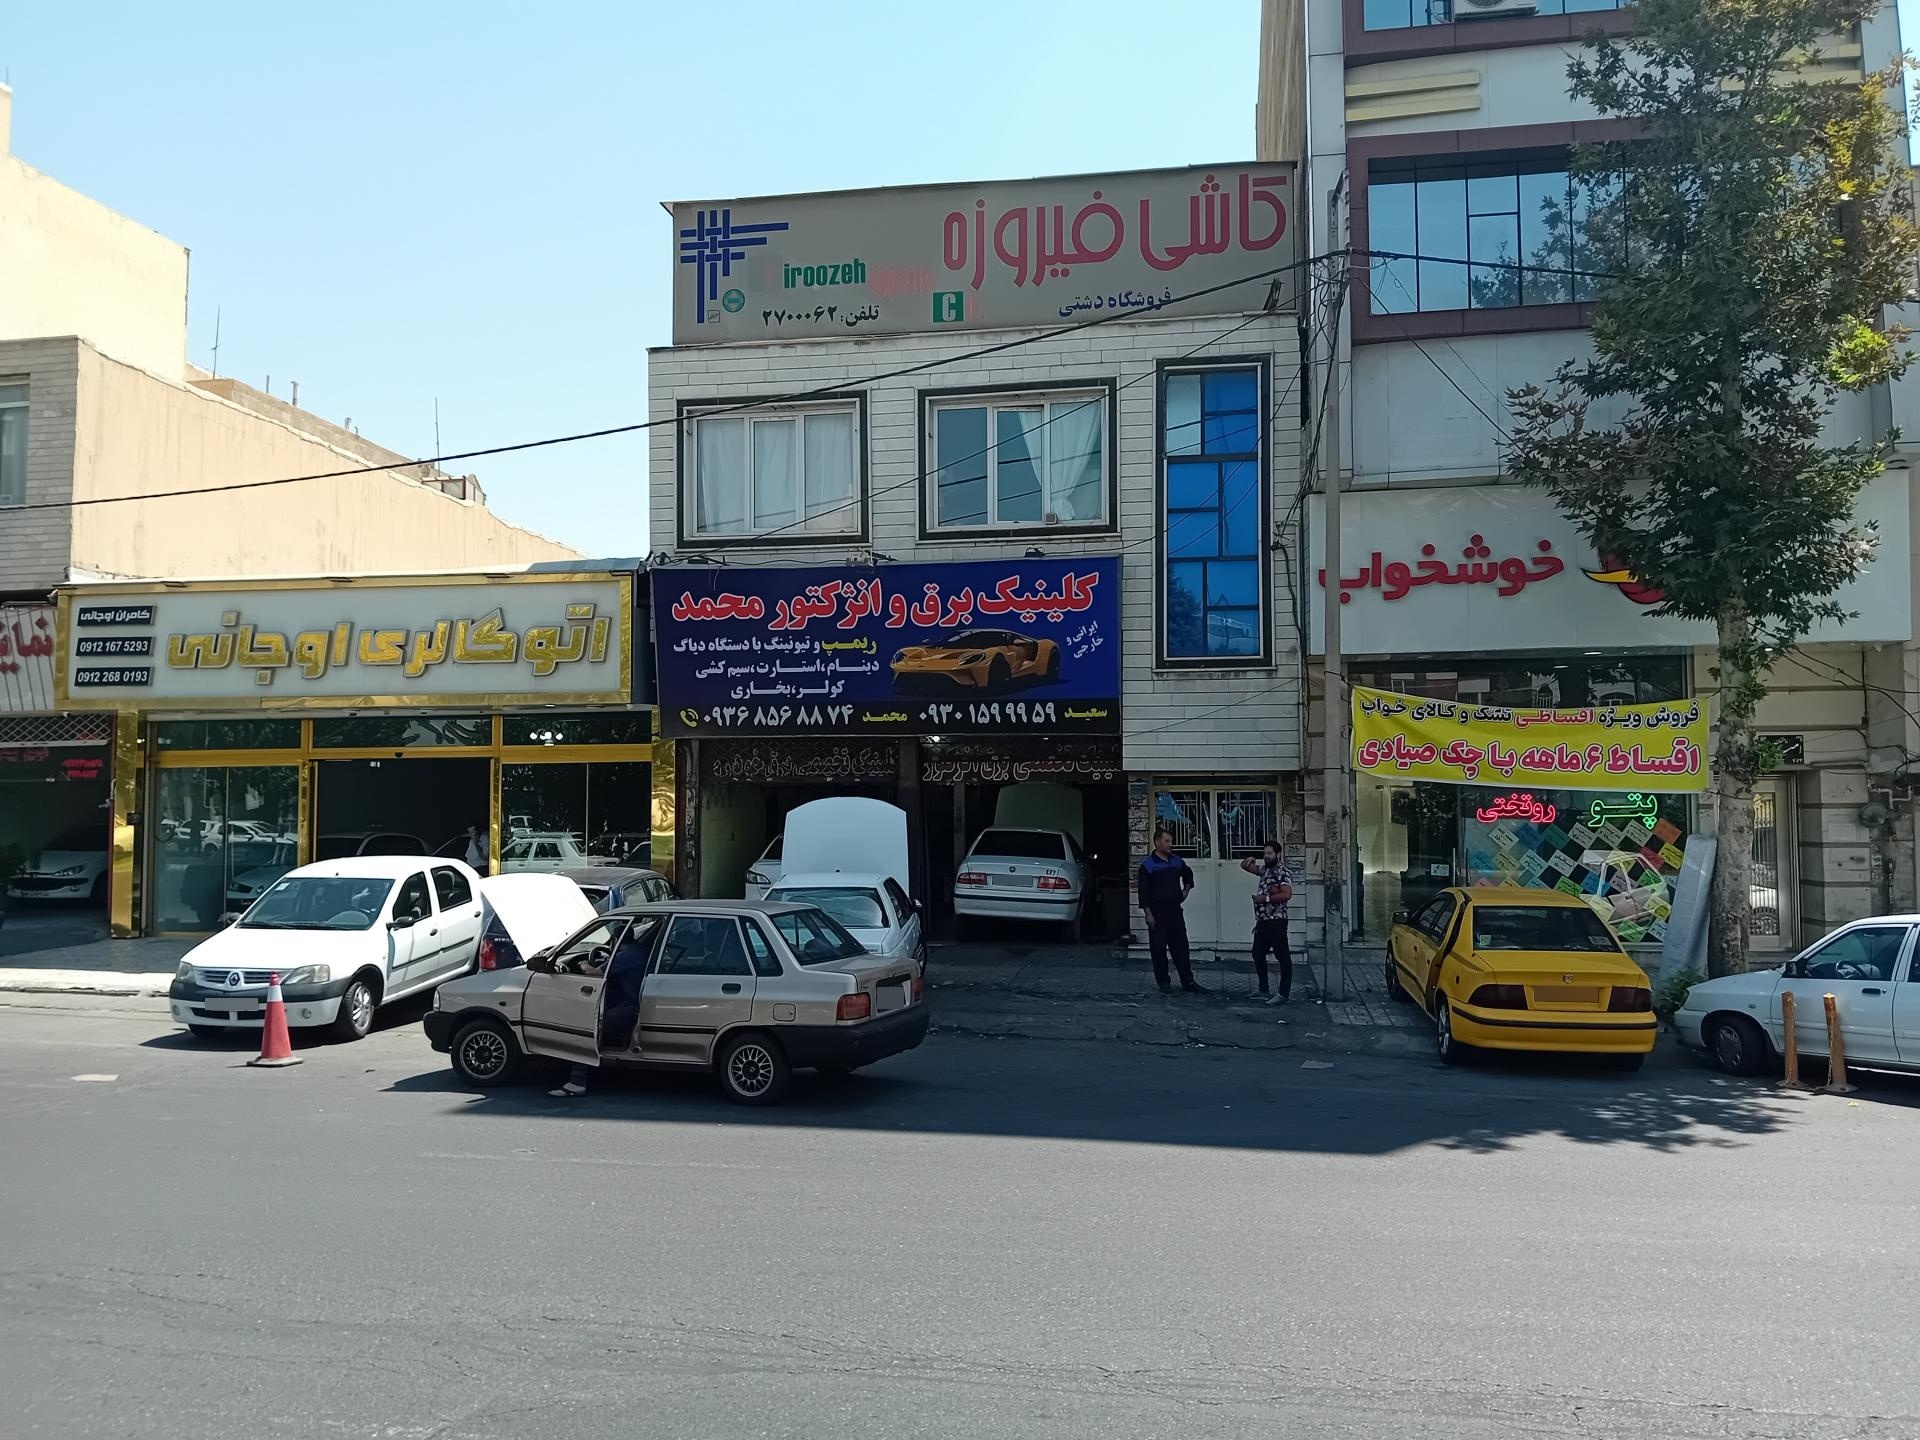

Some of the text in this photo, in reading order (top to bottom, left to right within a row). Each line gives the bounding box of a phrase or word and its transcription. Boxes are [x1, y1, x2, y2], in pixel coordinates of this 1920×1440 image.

[943, 190, 1125, 290] فیروزه
[1059, 286, 1171, 317] فروشگاه دشتی
[1318, 534, 1564, 604] خوشخواب
[80, 608, 150, 622] کامران اوجانی
[672, 571, 1099, 630] کلینیک برق و انژکتور محمد
[80, 641, 148, 652] 0912 167 5293
[166, 610, 349, 686] اوجانی
[521, 603, 611, 676] اتو
[673, 636, 877, 656] ریمپ و تیونینگ با دستگاه دیاگ
[1072, 620, 1099, 643] ایرانی
[1073, 635, 1104, 659] خارجی
[77, 671, 147, 683] 0912 268 0193
[695, 660, 726, 679] کشی
[862, 710, 908, 723] محمد
[1064, 706, 1108, 720] سعید
[1361, 696, 1701, 730] فروش ویژه اقساطی تشک و کالای خواب
[1357, 734, 1439, 770] صیادی
[1440, 737, 1485, 780] چک
[1486, 742, 1515, 778] با
[1605, 737, 1701, 775] اقساط
[1476, 792, 1658, 830] روتختی پتو
